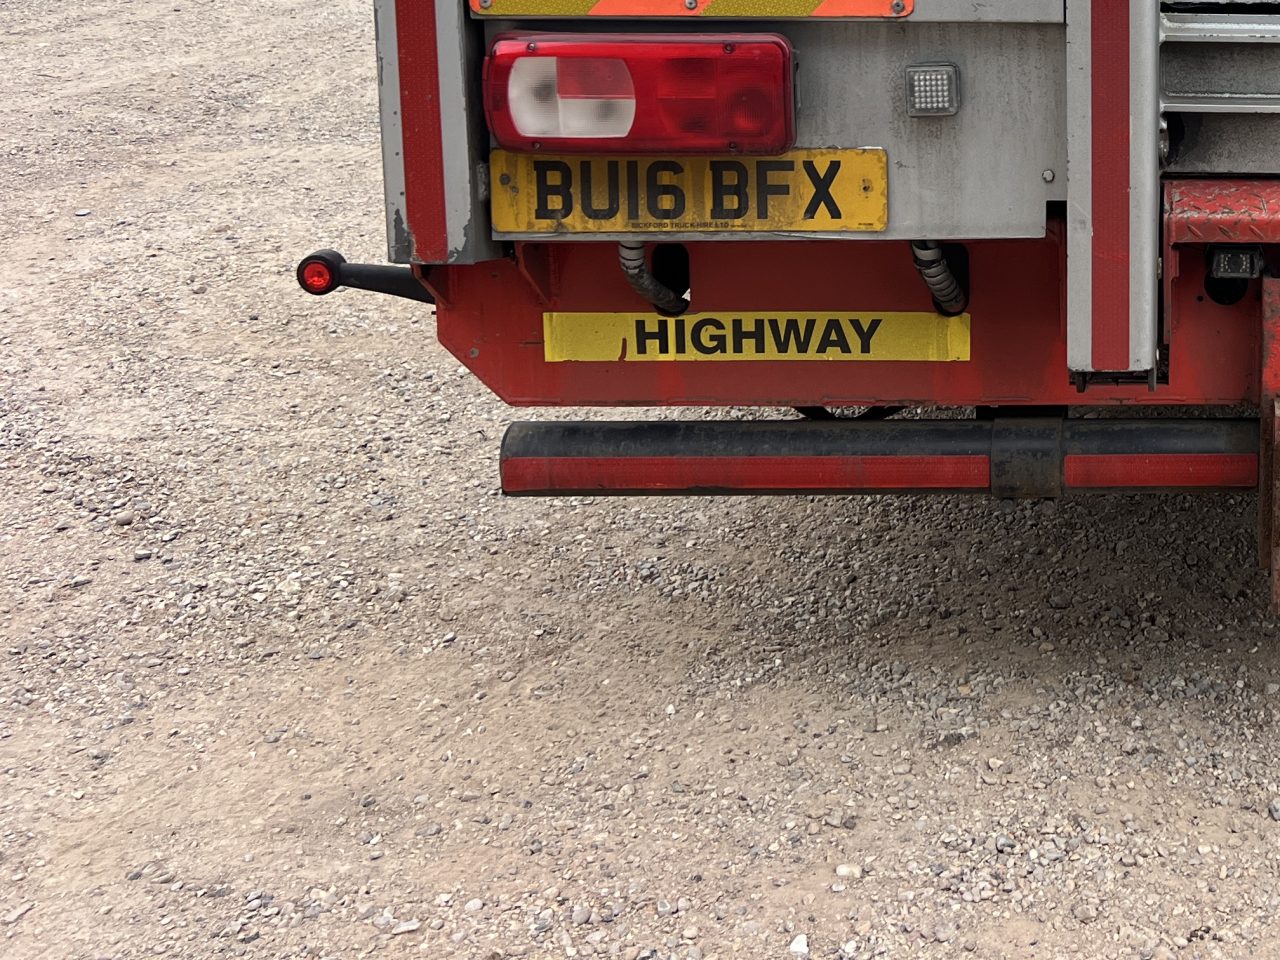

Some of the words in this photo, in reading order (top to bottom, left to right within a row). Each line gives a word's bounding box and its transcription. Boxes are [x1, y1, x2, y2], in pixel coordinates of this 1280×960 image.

[533, 159, 686, 221] BU16
[710, 159, 842, 221] BFX
[635, 318, 883, 354] HIGHWAY
